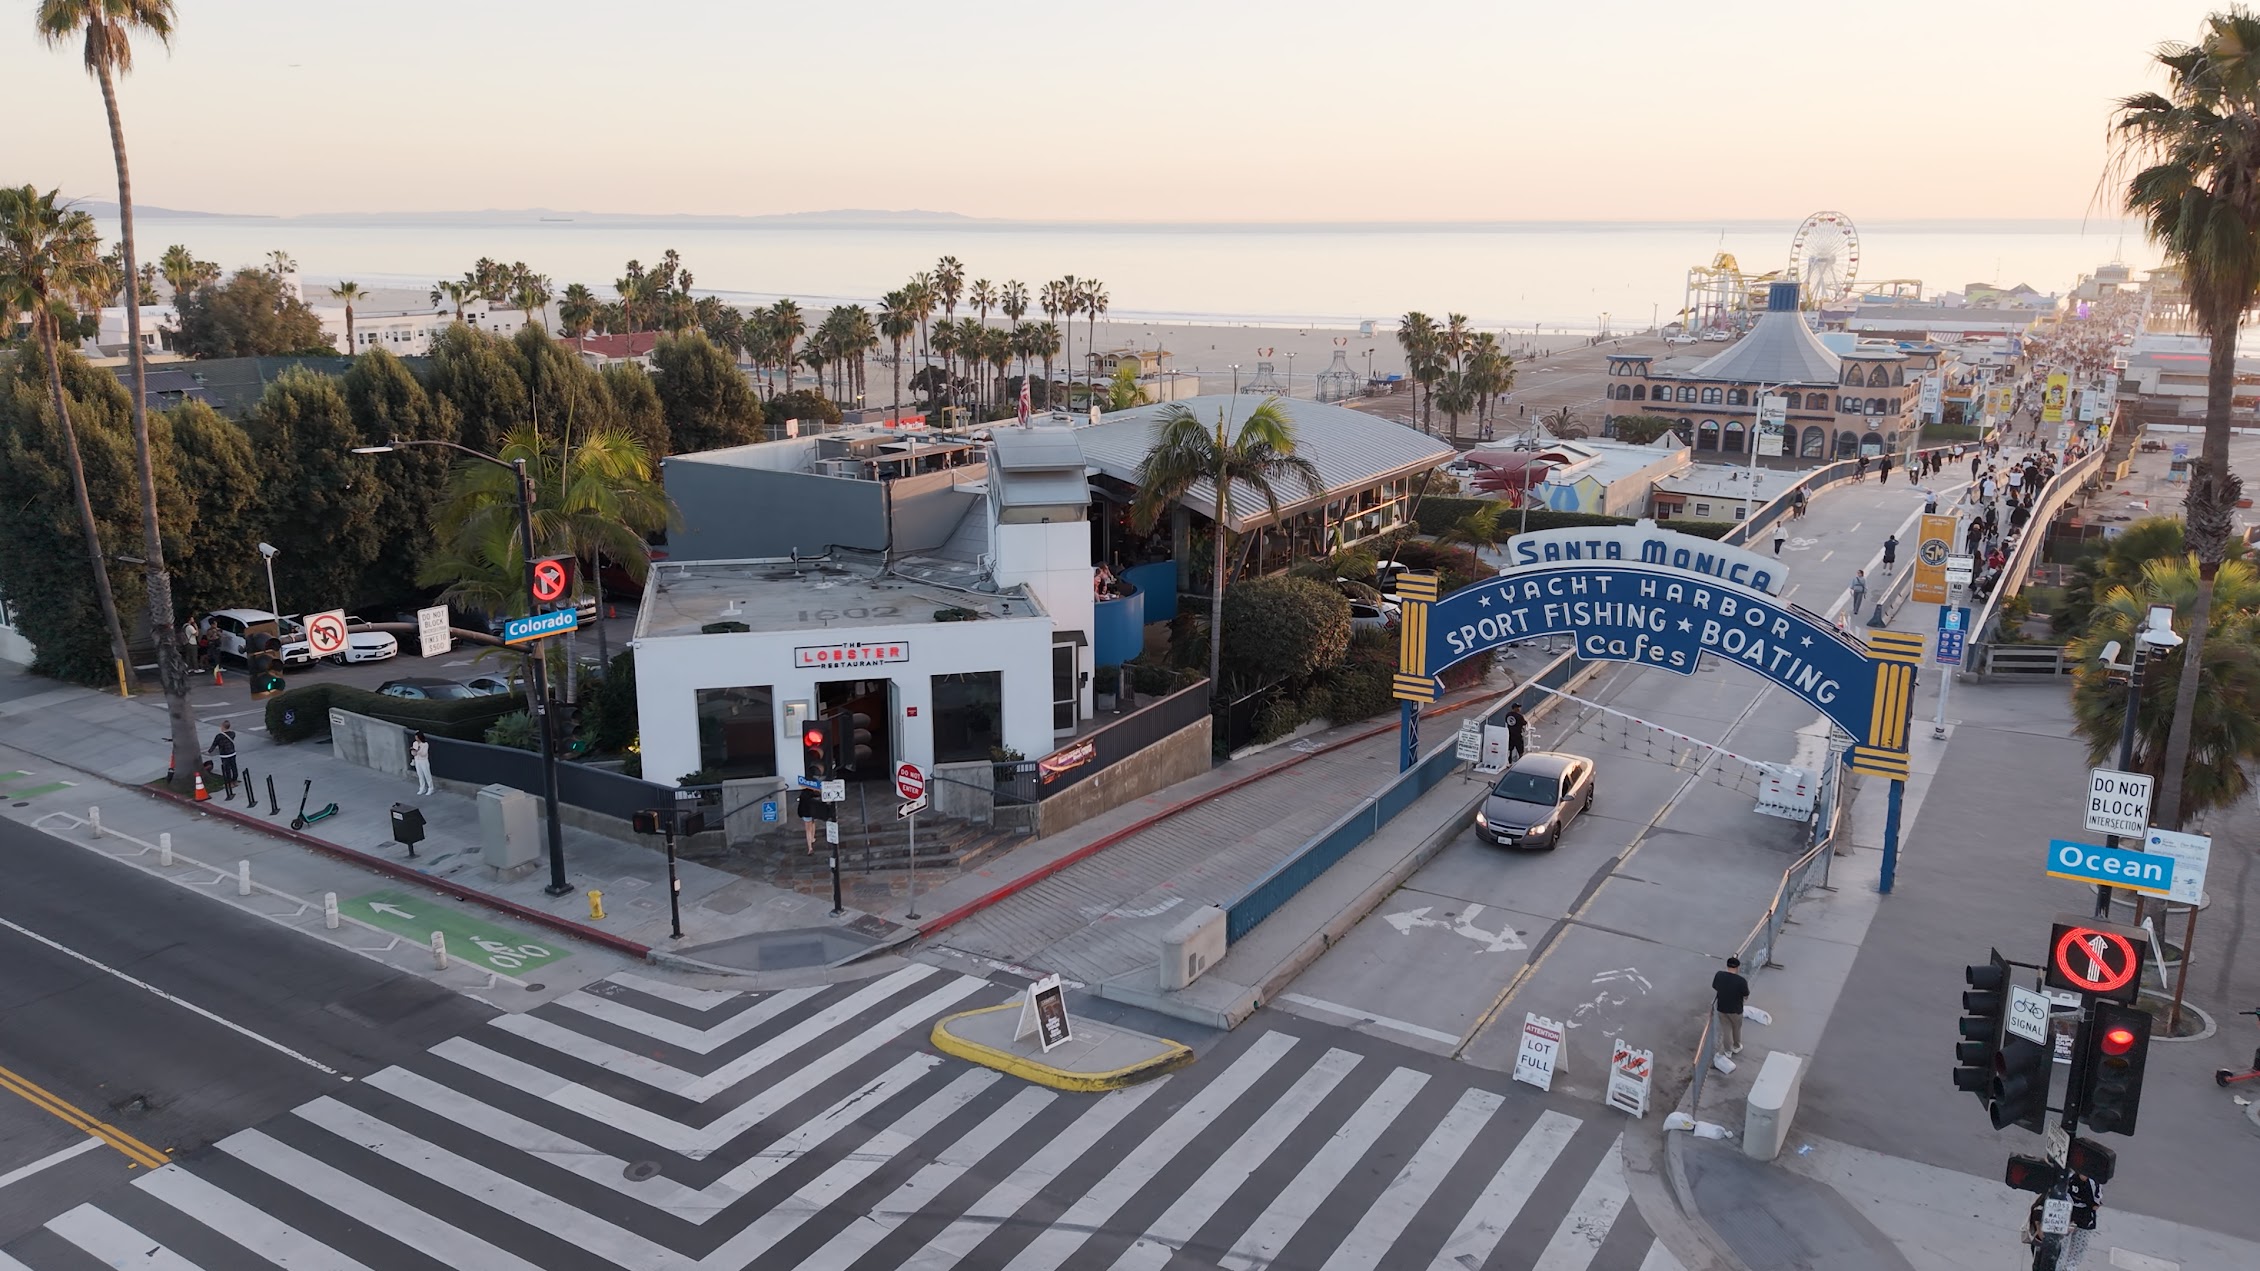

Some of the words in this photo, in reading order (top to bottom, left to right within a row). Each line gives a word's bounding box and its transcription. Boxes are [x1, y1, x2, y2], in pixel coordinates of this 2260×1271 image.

[1517, 540, 1622, 565] SANTA
[1641, 539, 1771, 592] MONICA
[798, 607, 903, 622] 1602
[1500, 576, 1612, 604] YACHT
[1640, 579, 1790, 639] HARBOR
[422, 613, 431, 621] DO
[424, 619, 443, 628] BLOCK
[509, 613, 573, 636] Colorado
[804, 647, 900, 662] LOBSTER
[1446, 608, 1528, 655] SPORT
[1543, 601, 1667, 632] FISHING
[1700, 619, 1840, 704] BOATING
[821, 660, 884, 669] RESTAURANT
[798, 776, 818, 787] Ocean
[900, 768, 909, 776] DO
[910, 771, 921, 780] NOT
[902, 784, 919, 795] ENTER
[2094, 777, 2114, 793] DO
[2118, 781, 2147, 798] NOT
[2092, 797, 2144, 818] BLOCK
[2089, 815, 2142, 832] INTERSECTION
[2059, 846, 2163, 881] Ocean
[1526, 1025, 1559, 1040] ATTENTION
[2010, 1016, 2043, 1037] SIGNAL
[1527, 1040, 1551, 1055] LOT
[1521, 1054, 1550, 1073] FULL
[2048, 1201, 2070, 1210] CROSS
